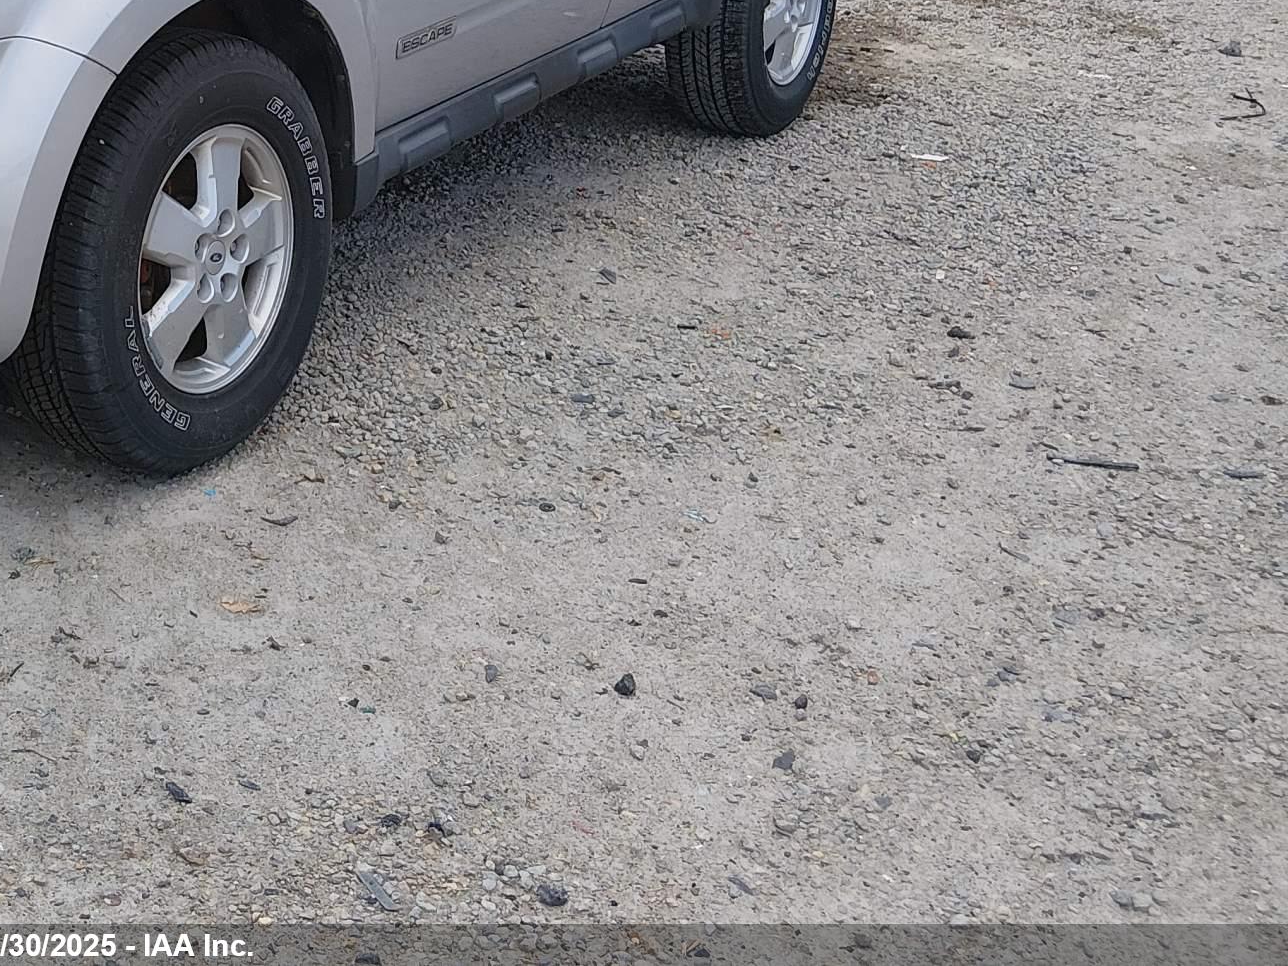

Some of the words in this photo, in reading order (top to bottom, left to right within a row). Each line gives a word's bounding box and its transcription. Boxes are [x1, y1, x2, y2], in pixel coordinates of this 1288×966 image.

[401, 23, 454, 53] ESCAPE
[266, 96, 326, 219] GRABBER
[124, 305, 191, 431] GENERAL
